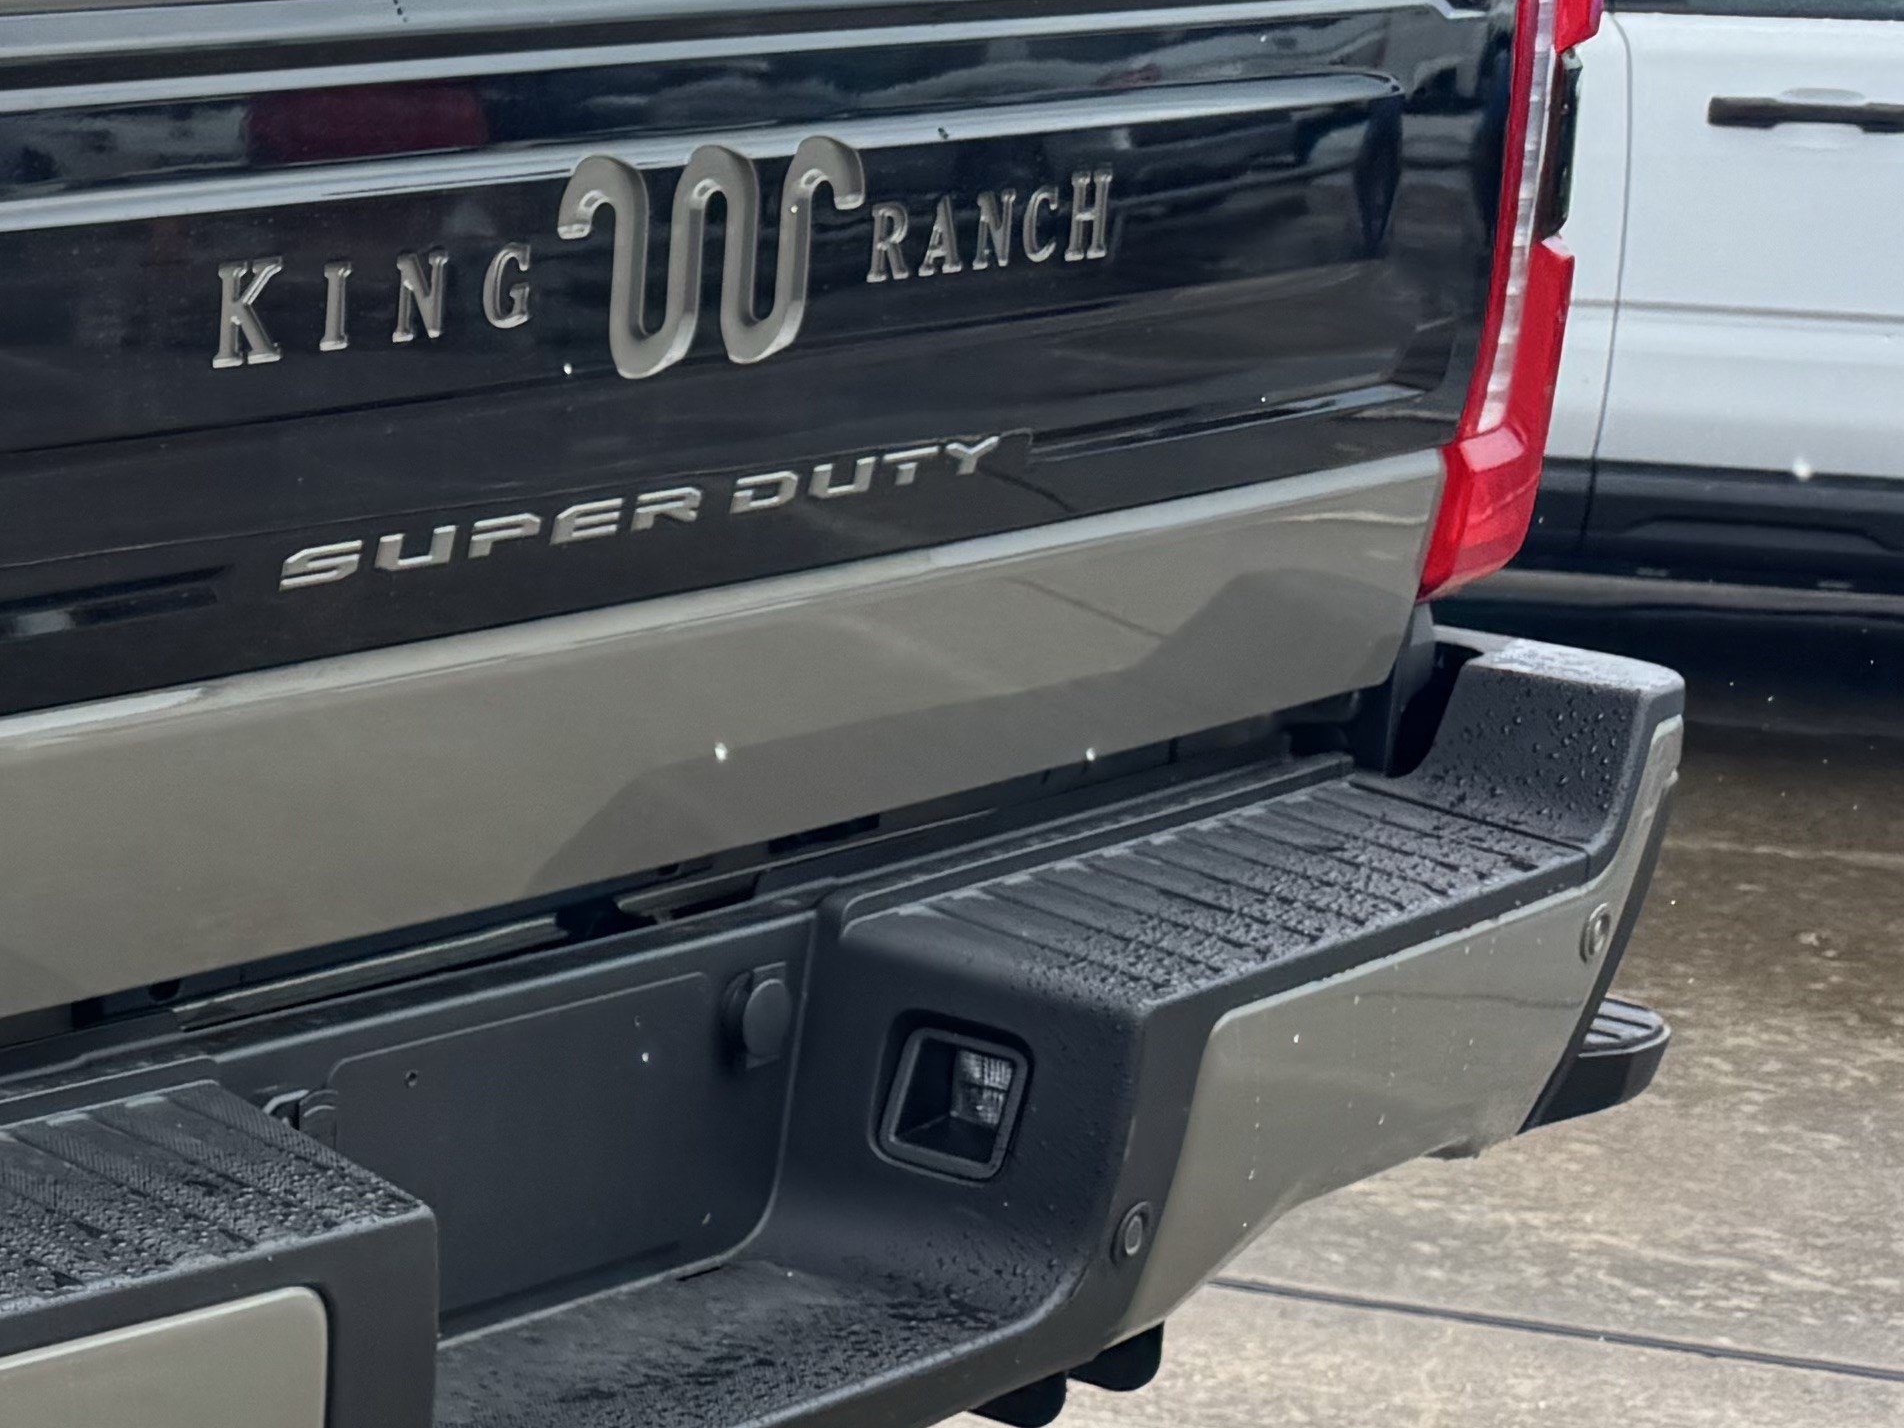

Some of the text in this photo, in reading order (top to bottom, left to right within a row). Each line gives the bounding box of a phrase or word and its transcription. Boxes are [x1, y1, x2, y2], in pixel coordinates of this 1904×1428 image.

[211, 241, 532, 369] KING
[865, 169, 1114, 285] RANCH
[278, 434, 1001, 591] SUPER DUTY
